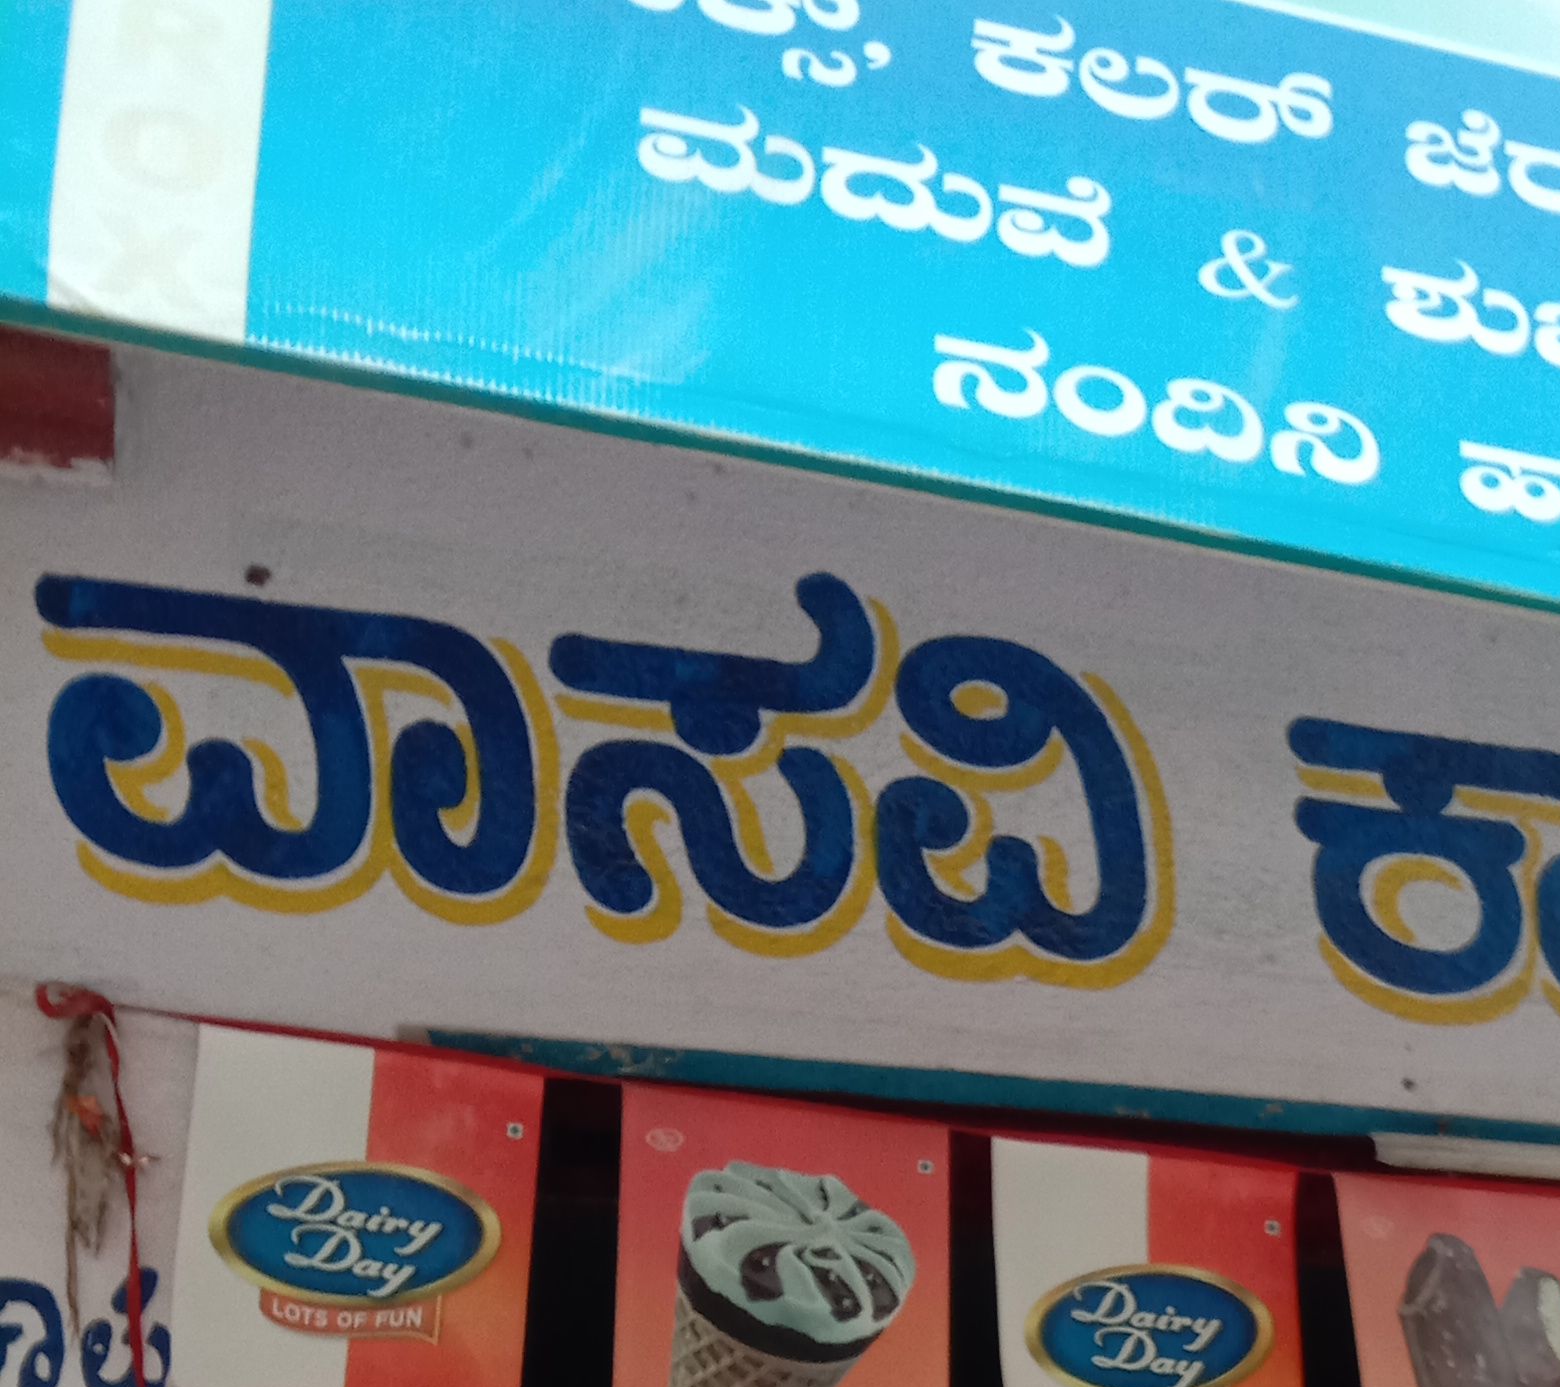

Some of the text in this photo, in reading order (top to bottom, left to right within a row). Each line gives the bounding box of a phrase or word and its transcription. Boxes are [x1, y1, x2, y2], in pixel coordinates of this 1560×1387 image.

[972, 14, 1334, 145] ಕಲರ್
[637, 103, 1113, 269] ಮದುವೆ
[1198, 229, 1299, 310] &
[933, 326, 1381, 487] ನಂದಿನಿ
[35, 572, 1165, 985] ವಾಸವಿ
[266, 1175, 443, 1256] Dairy
[284, 1223, 417, 1298] Day
[272, 1298, 424, 1330] LOTS OF FUN
[1070, 1280, 1224, 1352] Dairy
